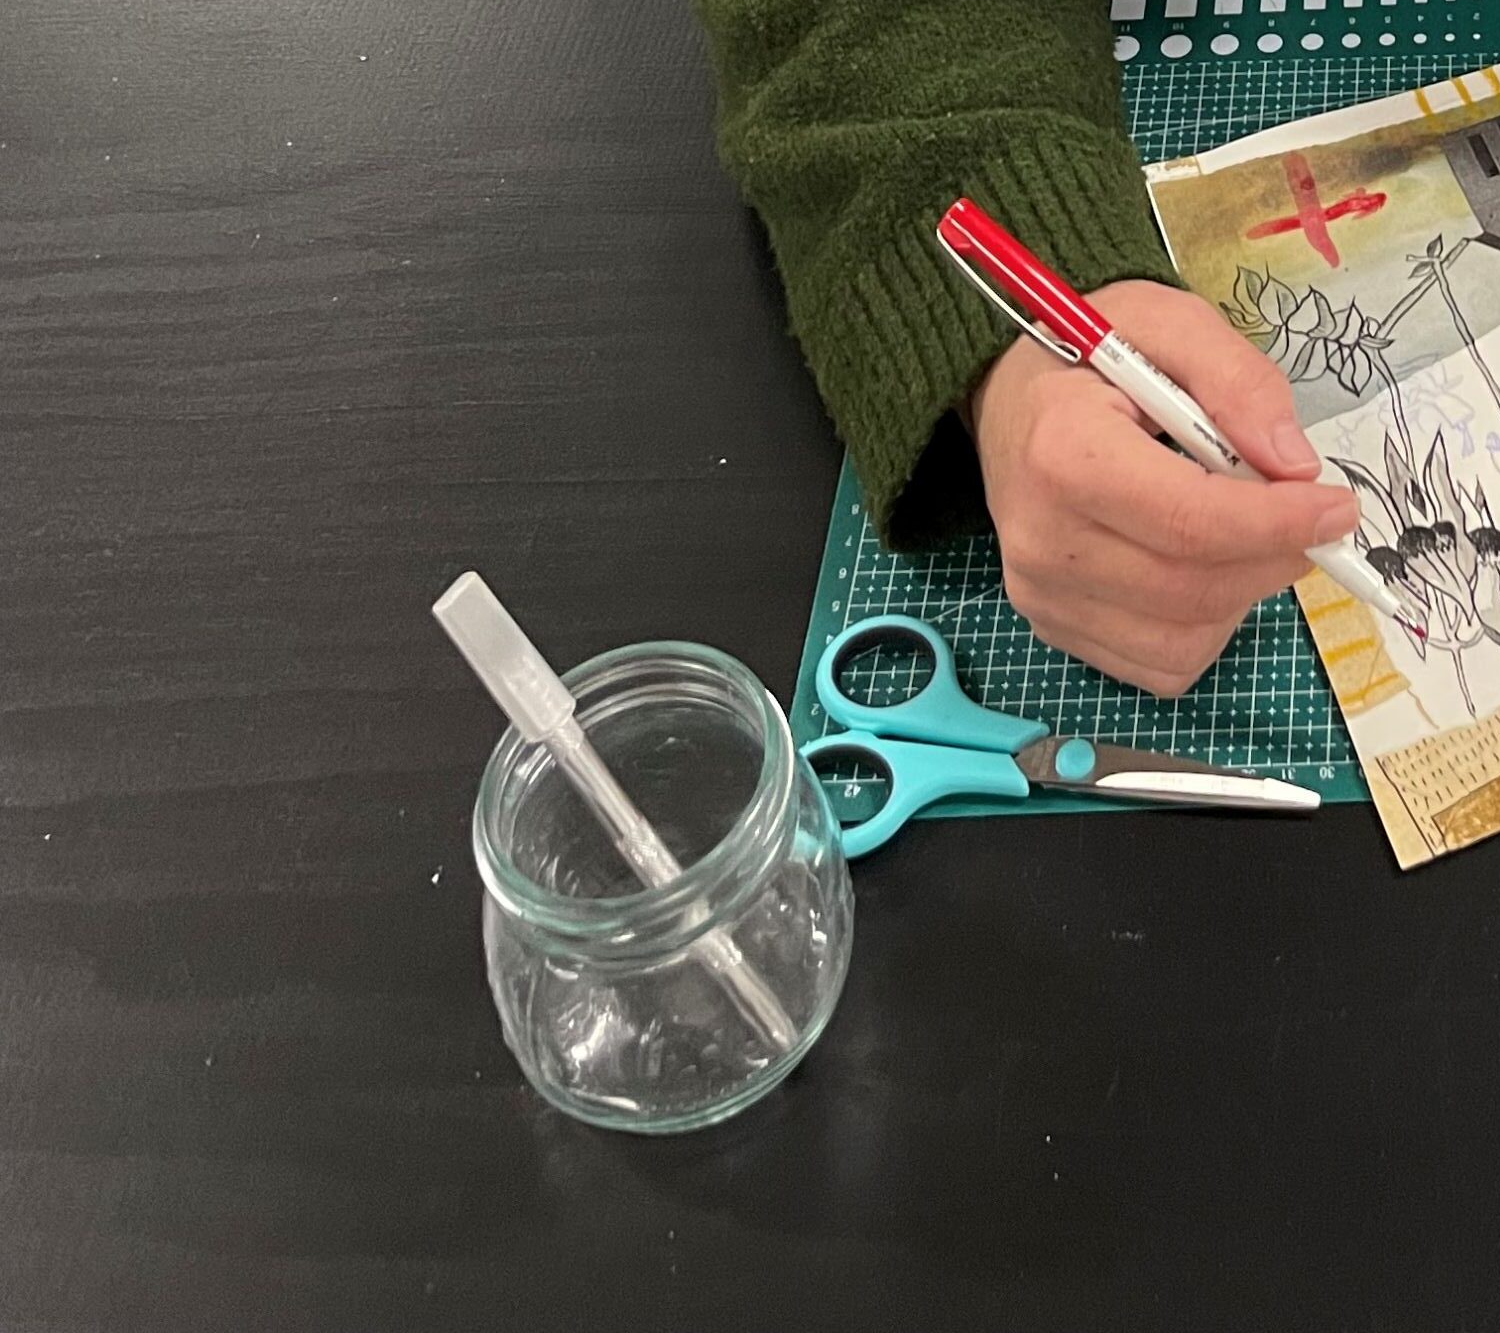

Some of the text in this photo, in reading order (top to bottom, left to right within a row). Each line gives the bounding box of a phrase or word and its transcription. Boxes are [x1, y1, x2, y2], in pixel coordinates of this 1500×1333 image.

[1281, 767, 1295, 781] 31
[1320, 767, 1335, 779] 30
[845, 784, 861, 797] 42
